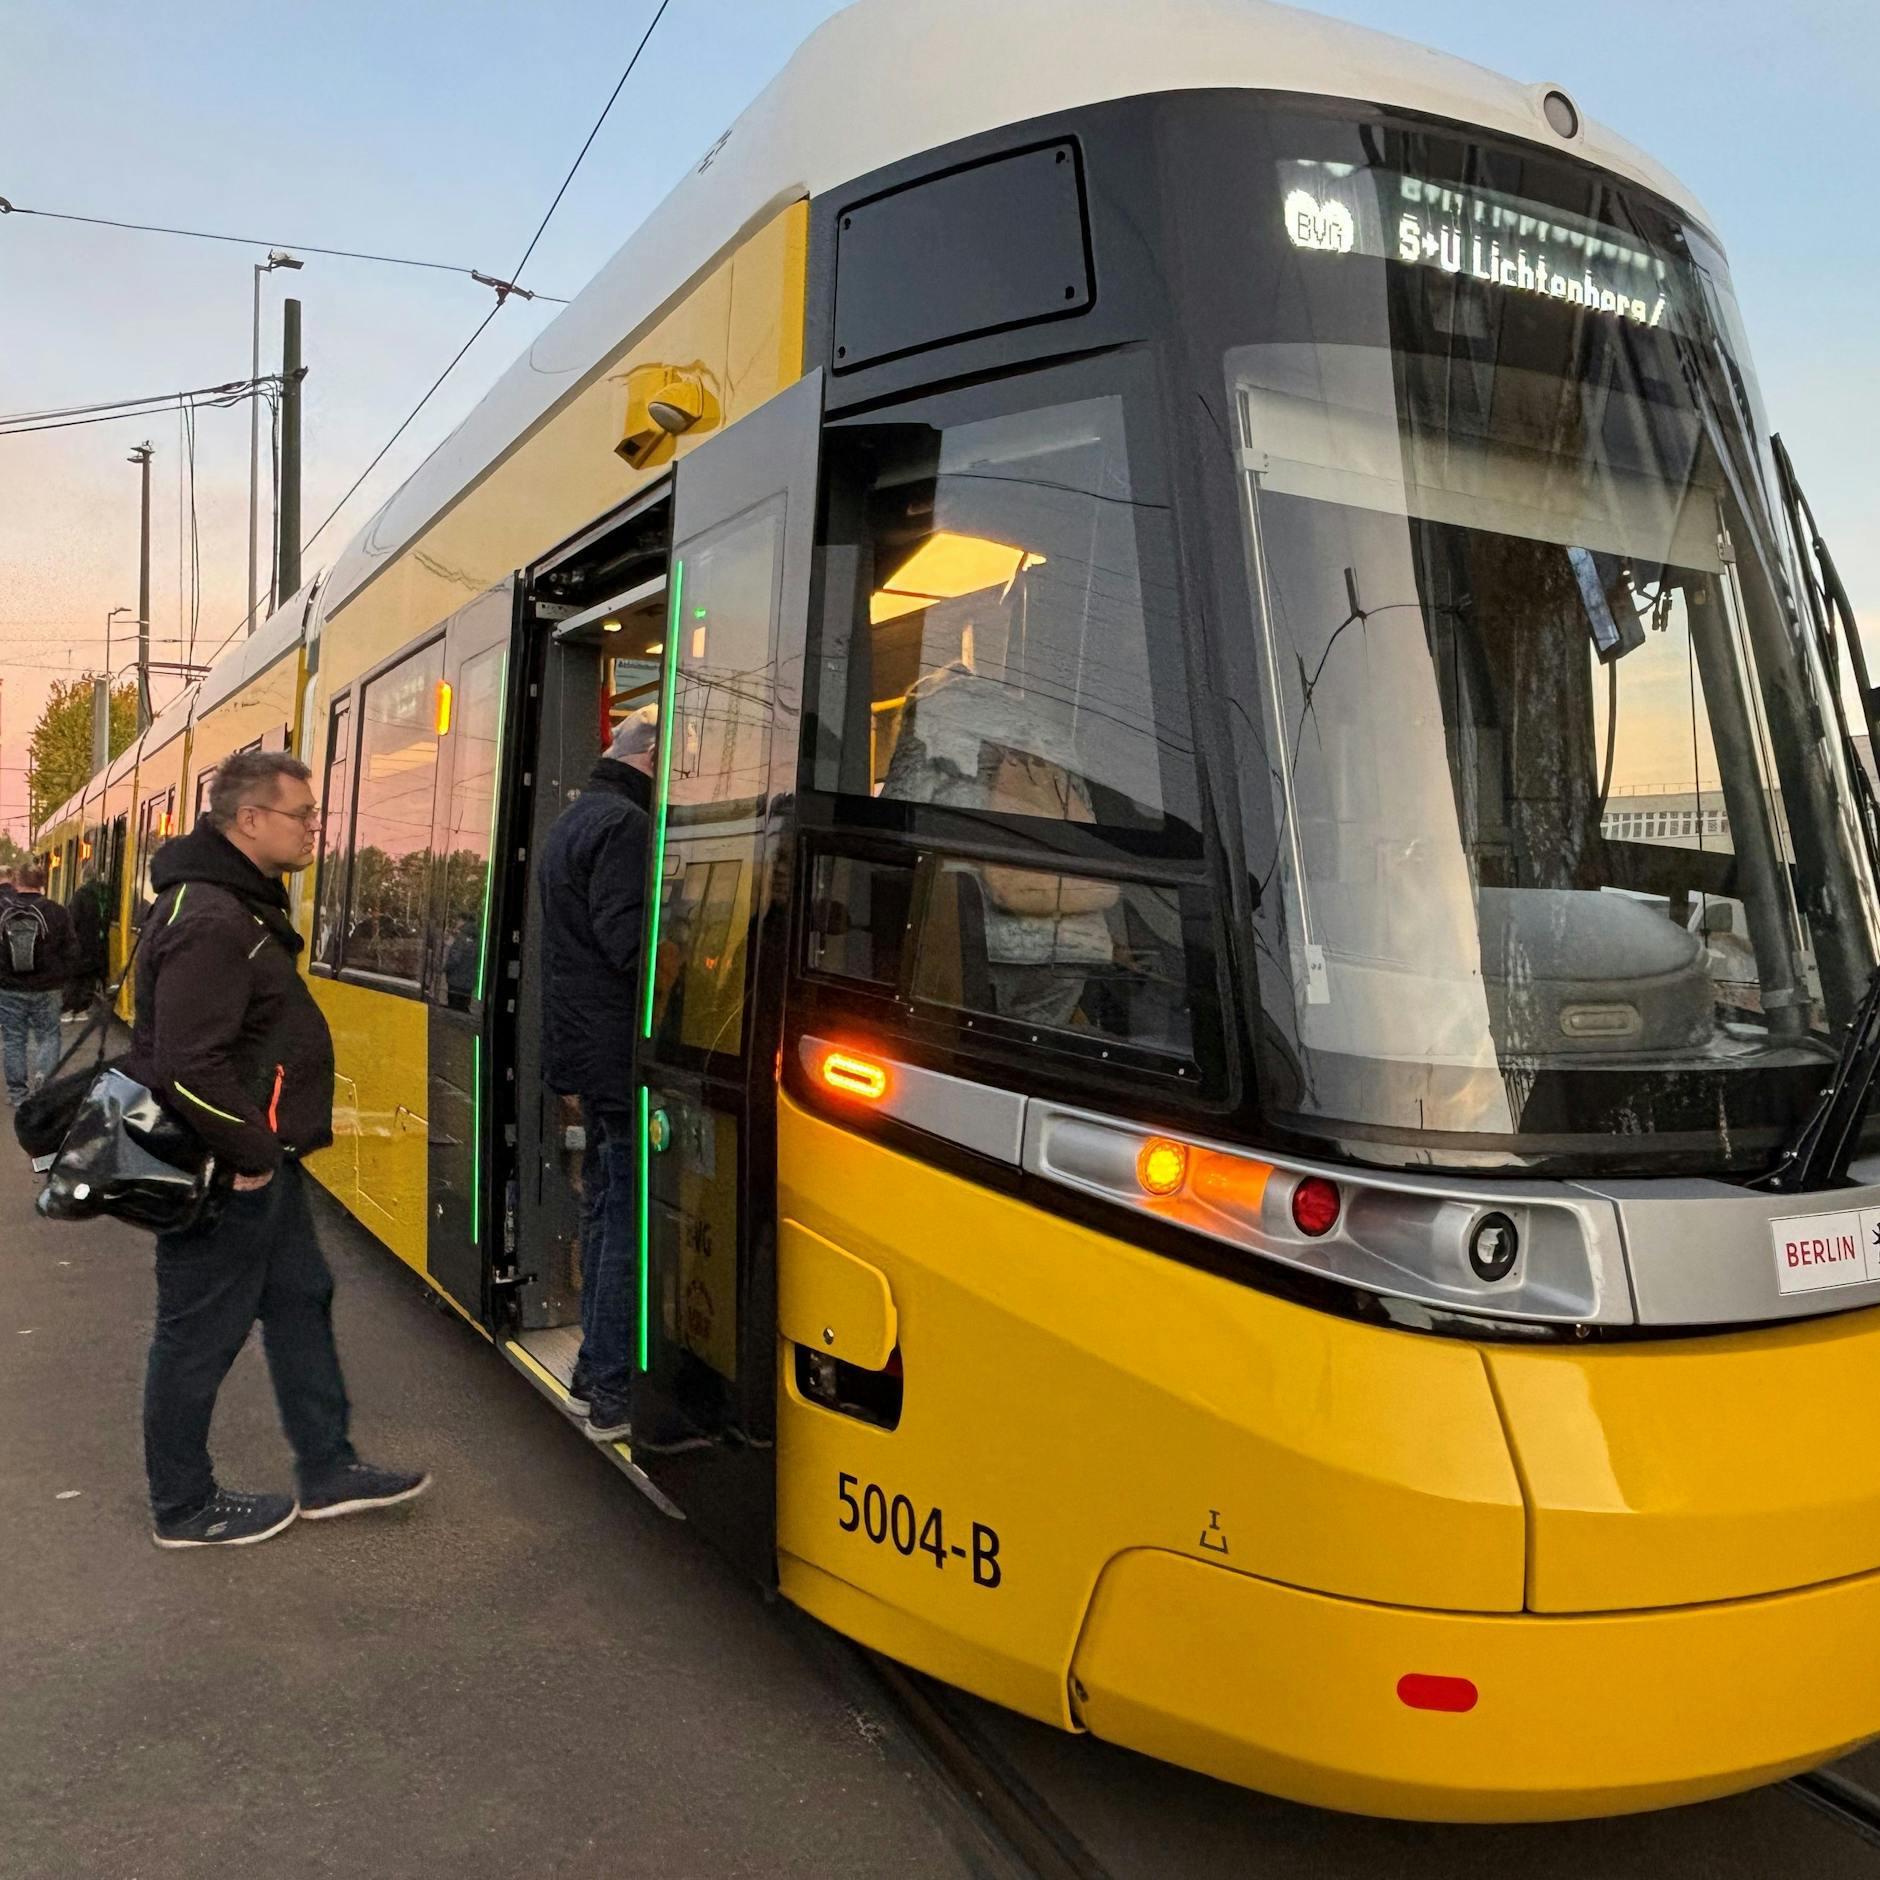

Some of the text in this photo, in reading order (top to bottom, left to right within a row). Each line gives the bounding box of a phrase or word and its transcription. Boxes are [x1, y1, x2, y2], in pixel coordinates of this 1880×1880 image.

[1399, 213, 1461, 273] S+U
[1785, 1235, 1856, 1268] BERLIN
[838, 1471, 1002, 1589] 5004-B
